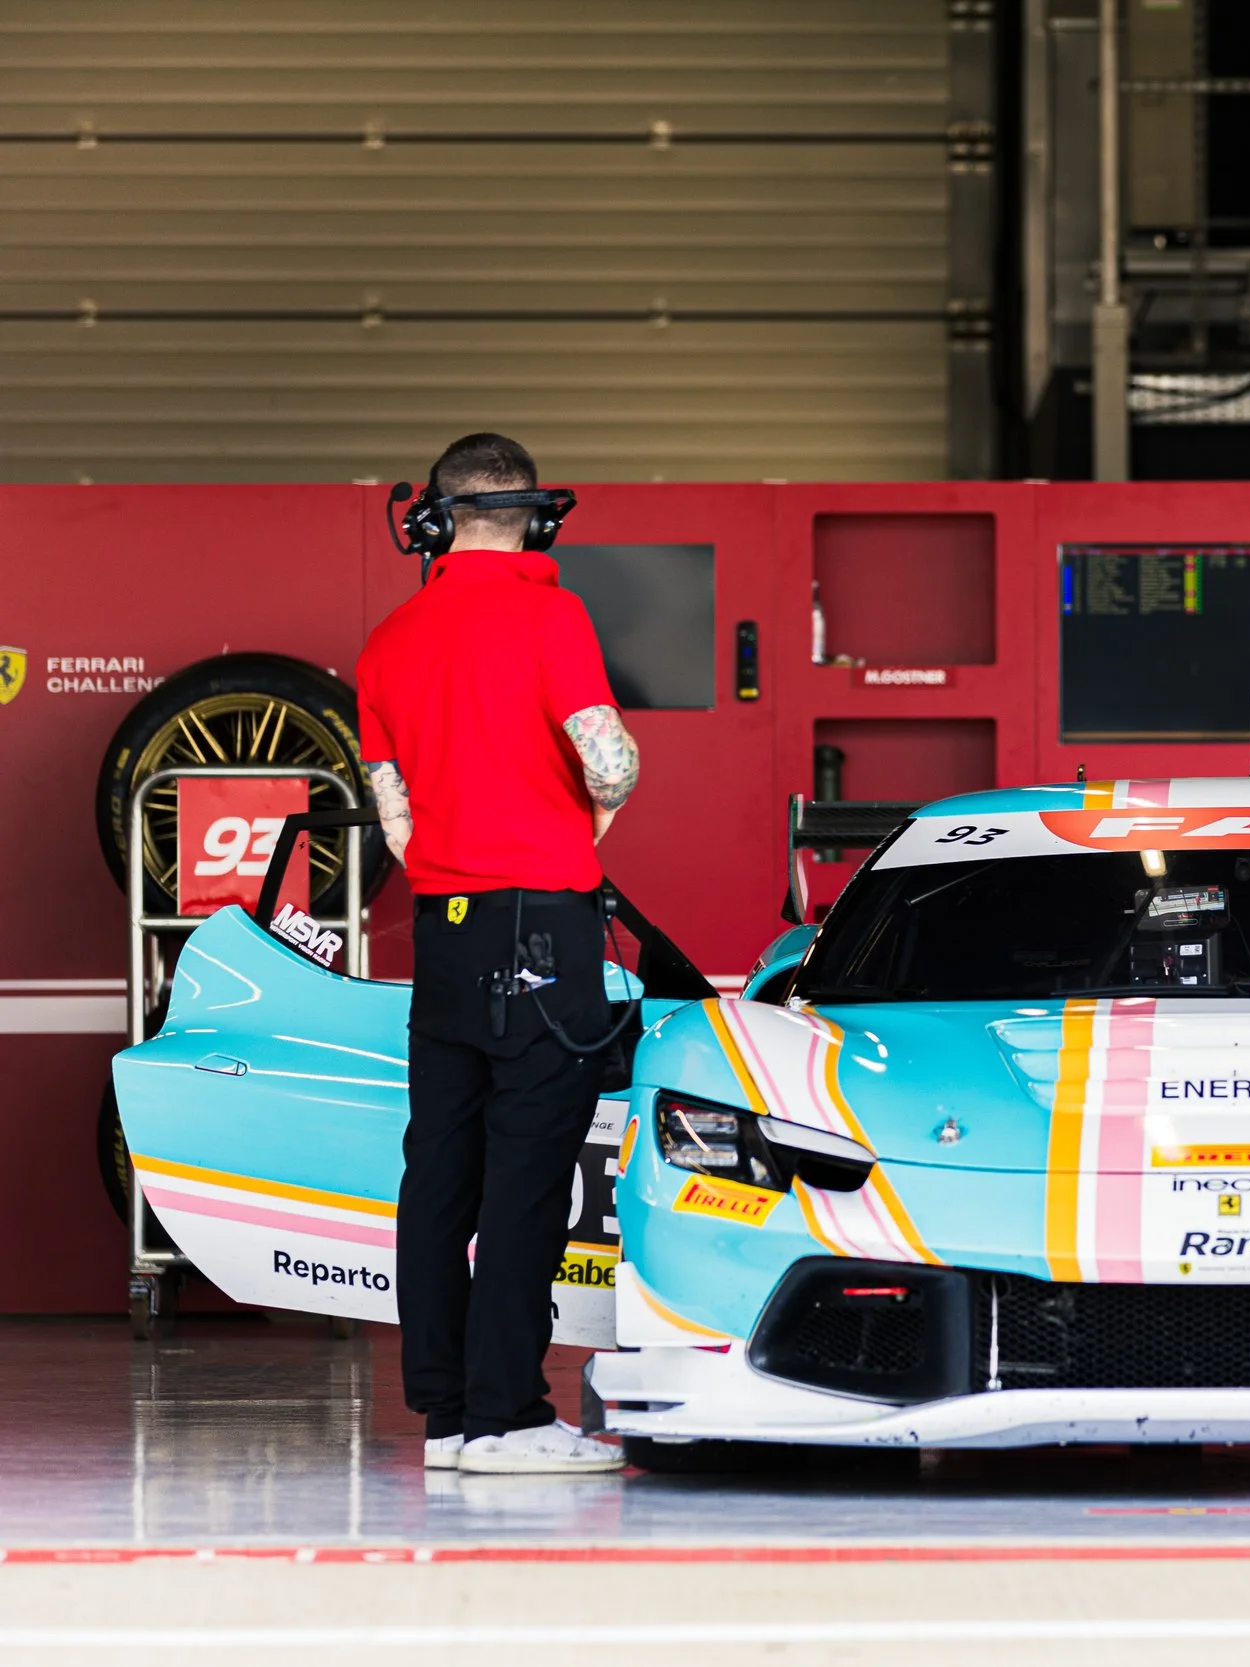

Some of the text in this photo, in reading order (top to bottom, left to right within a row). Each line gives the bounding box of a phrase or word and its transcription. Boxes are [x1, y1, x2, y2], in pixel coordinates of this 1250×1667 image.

[47, 656, 144, 673] FERRARI
[194, 816, 287, 876] 93
[934, 825, 1010, 846] 93
[272, 903, 343, 963] MSVR
[683, 1183, 769, 1215] PIRELLI
[273, 1249, 390, 1292] Reparto
